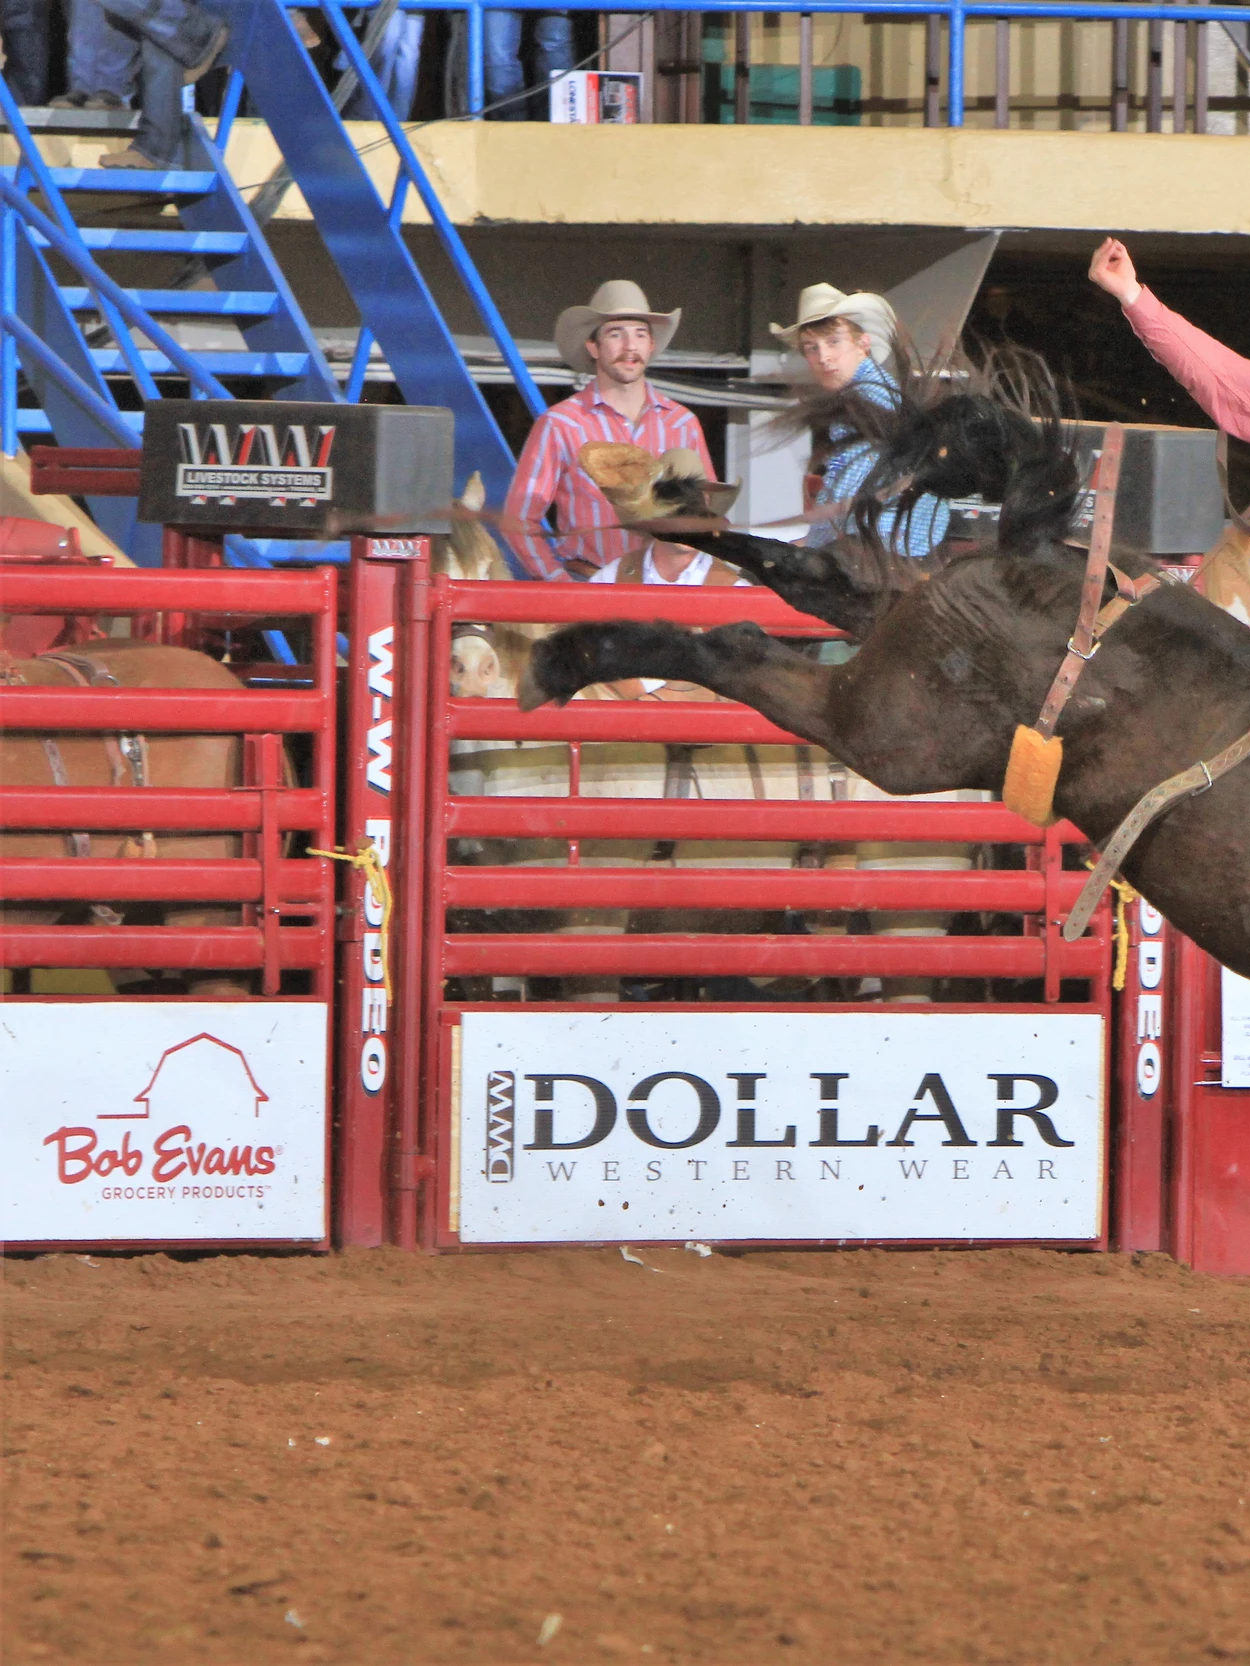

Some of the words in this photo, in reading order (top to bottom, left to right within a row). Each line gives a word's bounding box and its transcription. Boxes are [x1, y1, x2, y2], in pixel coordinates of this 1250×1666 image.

[186, 471, 258, 485] LIVESTOCK
[259, 473, 322, 487] SYSTEMS
[366, 625, 395, 797] W-W
[1137, 894, 1164, 1097] ODEO
[487, 1071, 515, 1183] DWW
[523, 1071, 1075, 1151] DOLLAR
[43, 1126, 143, 1184] Bob
[546, 1160, 842, 1181] WESTERN
[898, 1159, 1058, 1180] WEAR
[102, 1186, 176, 1200] GROCERY
[182, 1185, 265, 1199] PRODUCTS
